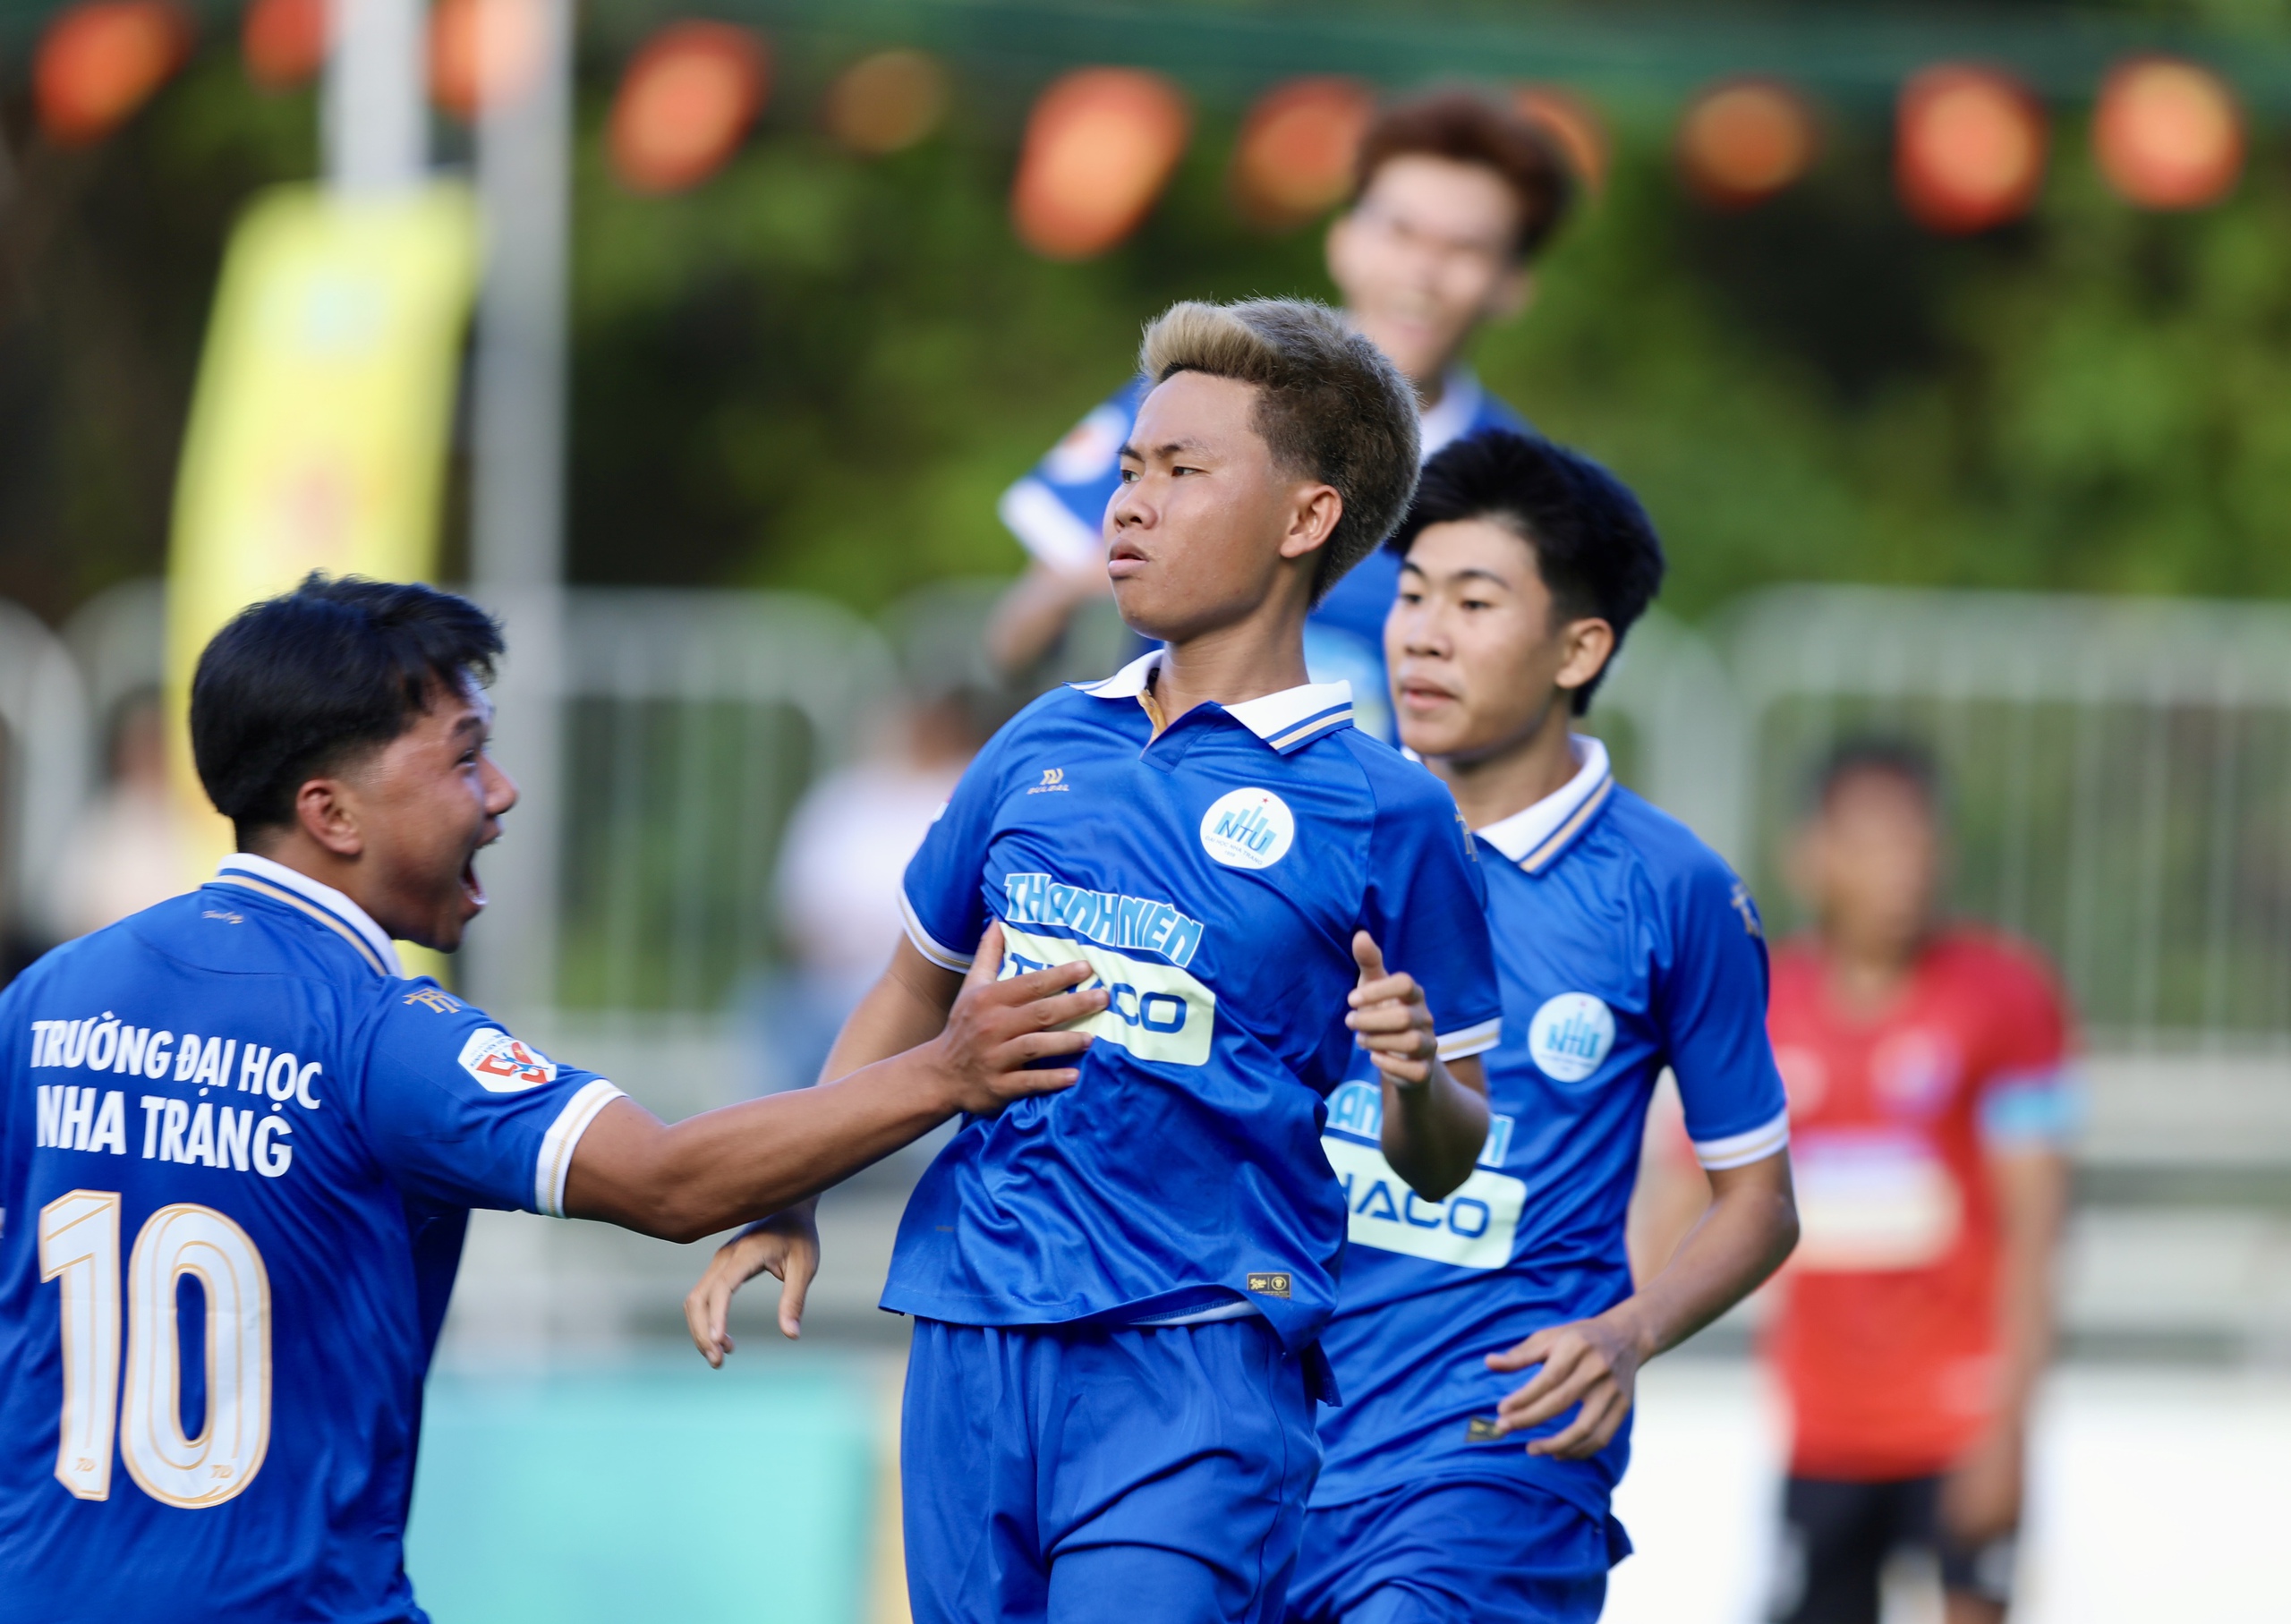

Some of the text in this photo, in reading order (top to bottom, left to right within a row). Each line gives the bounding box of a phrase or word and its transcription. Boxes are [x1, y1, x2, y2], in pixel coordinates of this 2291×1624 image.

[1218, 820, 1267, 851] NTU
[30, 1010, 323, 1112] TRƯỜNG ĐẠI HỌC
[37, 1084, 293, 1178] NHA TRANG
[38, 1188, 271, 1509] 10
